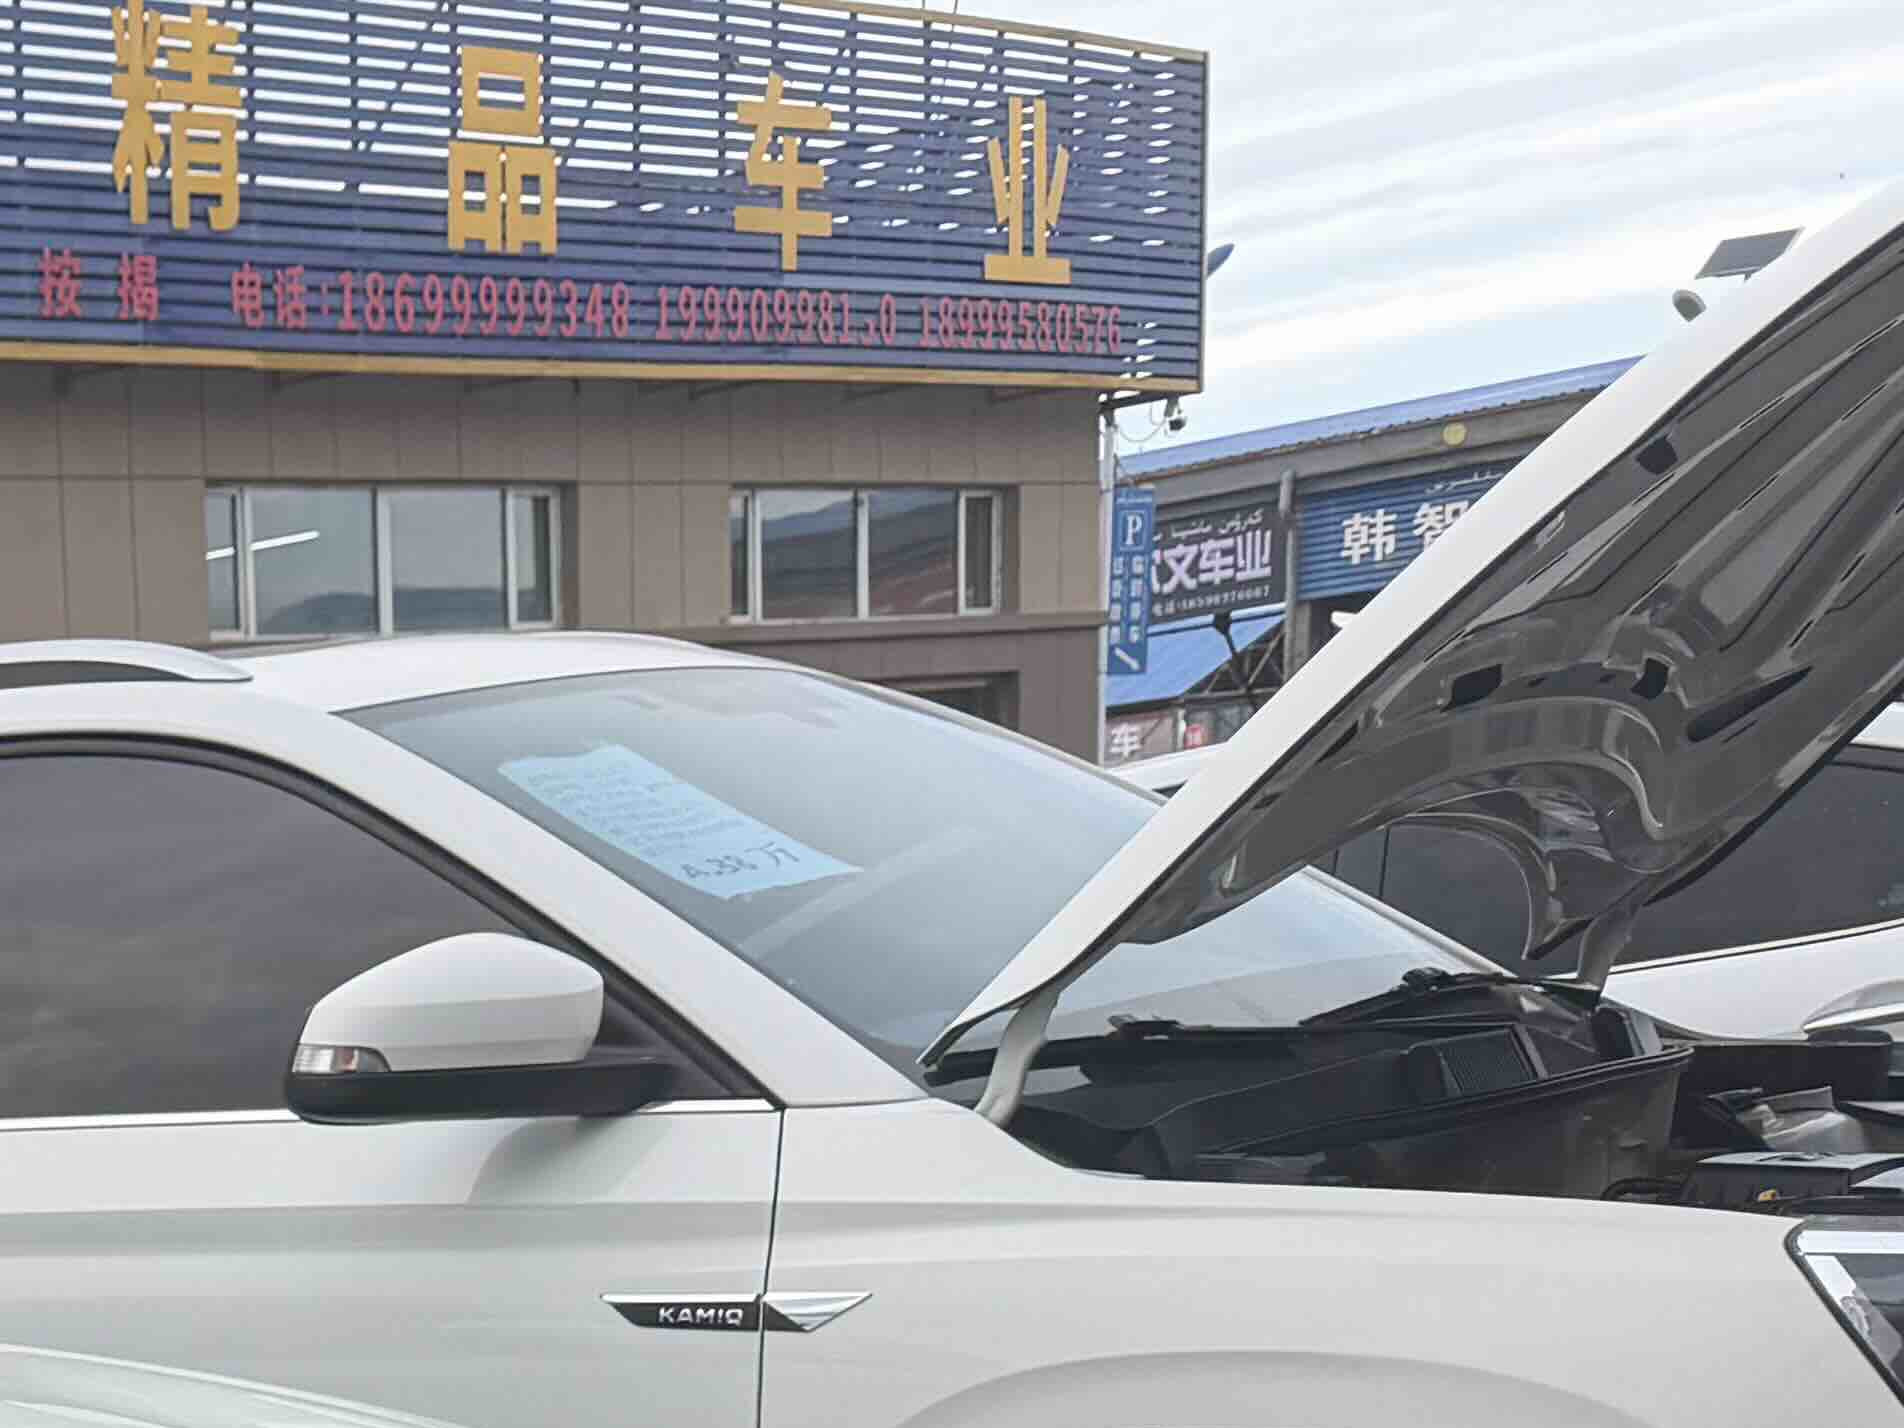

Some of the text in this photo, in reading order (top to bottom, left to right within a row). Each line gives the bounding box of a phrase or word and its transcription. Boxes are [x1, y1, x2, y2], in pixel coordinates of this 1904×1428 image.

[38, 247, 159, 322] 按揭
[1124, 514, 1143, 545] P
[657, 1306, 744, 1327] KAMIQ
